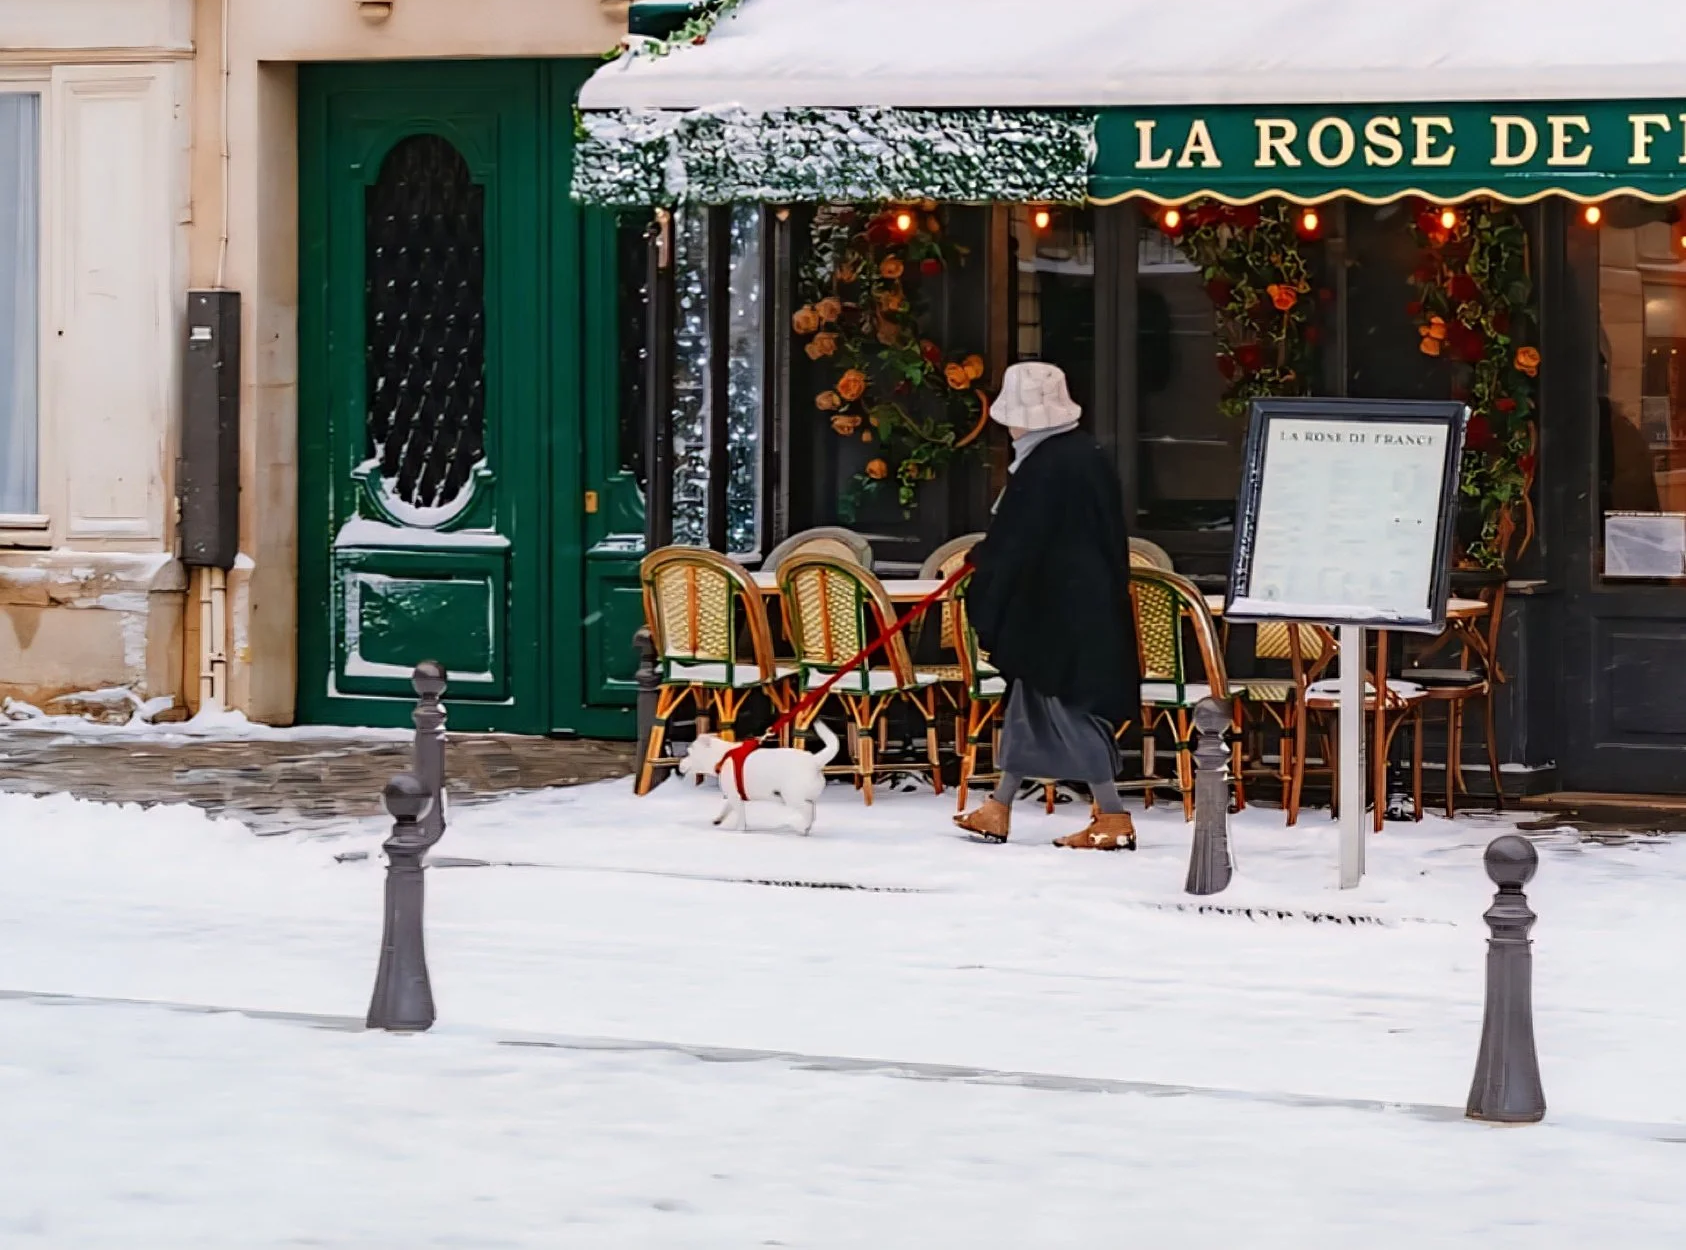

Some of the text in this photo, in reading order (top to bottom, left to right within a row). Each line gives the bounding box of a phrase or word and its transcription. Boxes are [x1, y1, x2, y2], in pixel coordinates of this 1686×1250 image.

[1134, 113, 1686, 169] LA ROSE DE F
[1280, 430, 1434, 447] LA ROSE DE FRANCE
